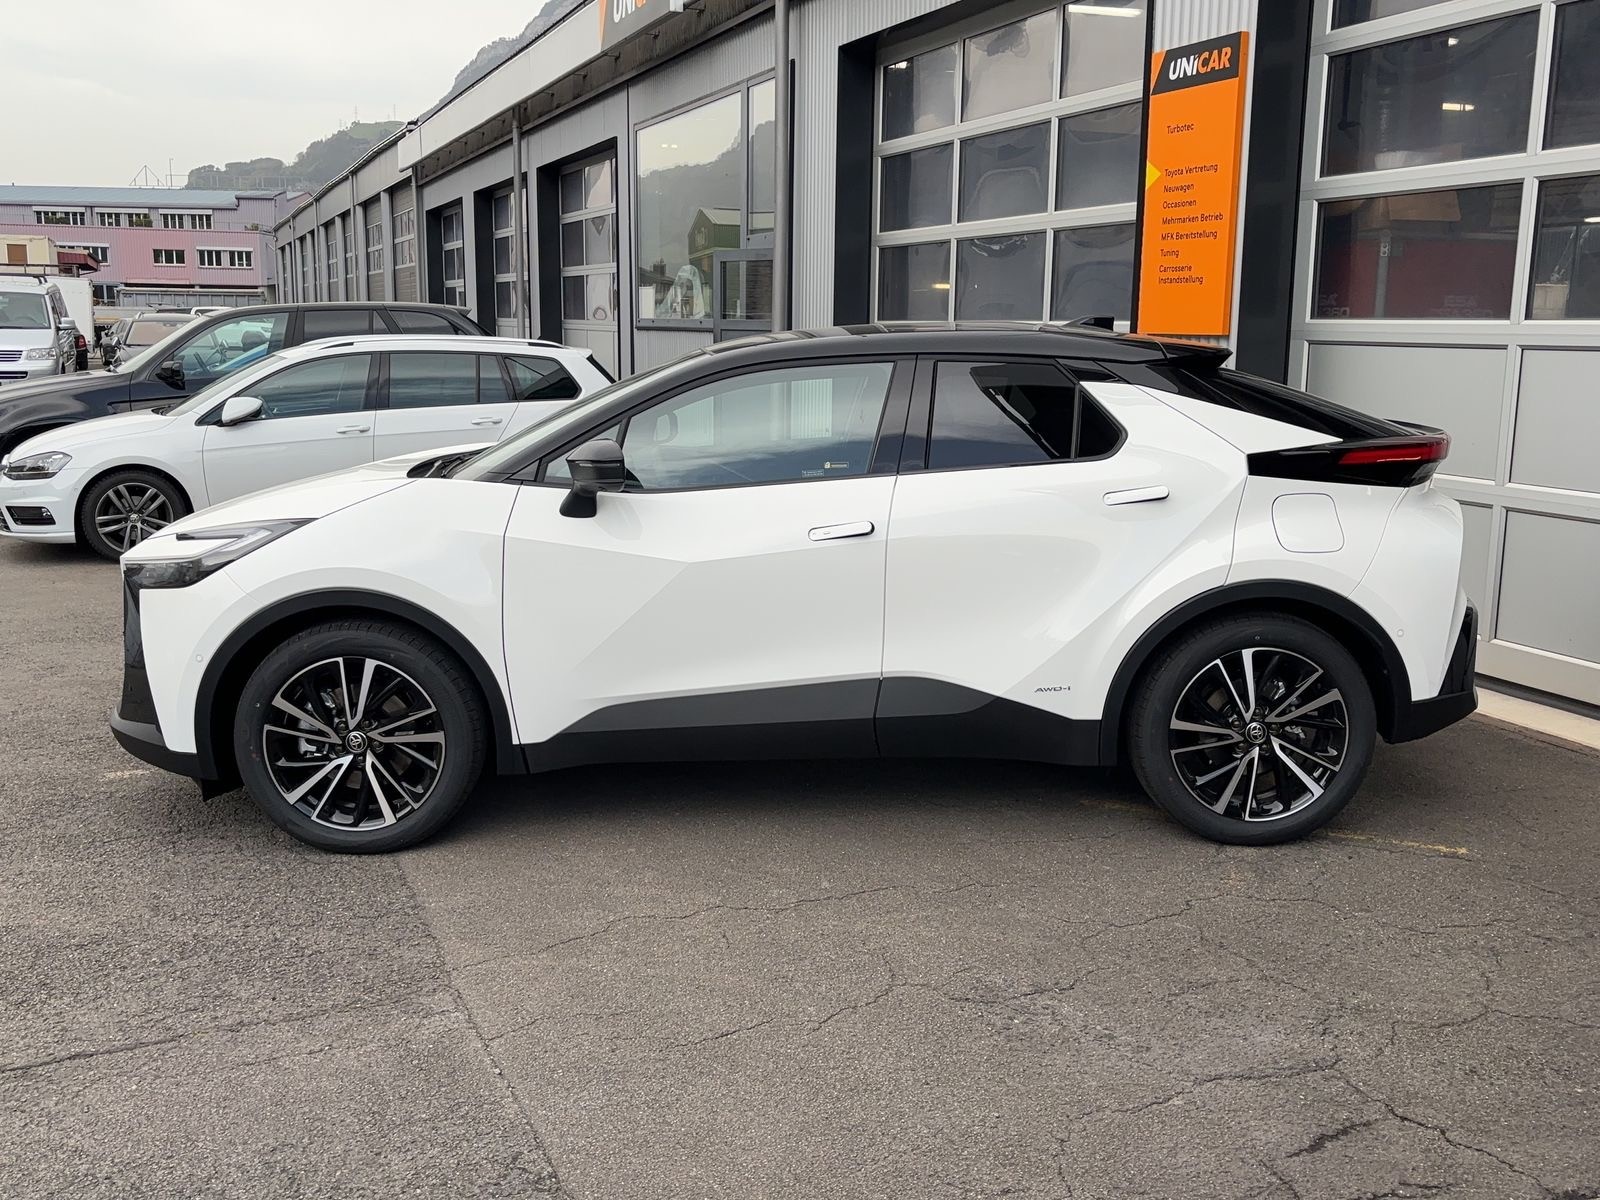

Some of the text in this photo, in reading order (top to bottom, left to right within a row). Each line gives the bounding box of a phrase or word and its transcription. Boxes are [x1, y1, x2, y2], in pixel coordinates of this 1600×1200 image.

[1167, 123, 1194, 134] Turbotec
[1165, 164, 1218, 178] Toyota Vertretung
[1163, 183, 1194, 193] Neuwagen
[1162, 199, 1197, 209] Occasionen
[1162, 212, 1224, 225] Mehrmarken Betrieb
[1161, 230, 1218, 241] MFK Bereitstellung
[1160, 249, 1179, 258] Tuning
[1159, 264, 1193, 273] Carrosserie
[1158, 275, 1204, 285] Instandstellung
